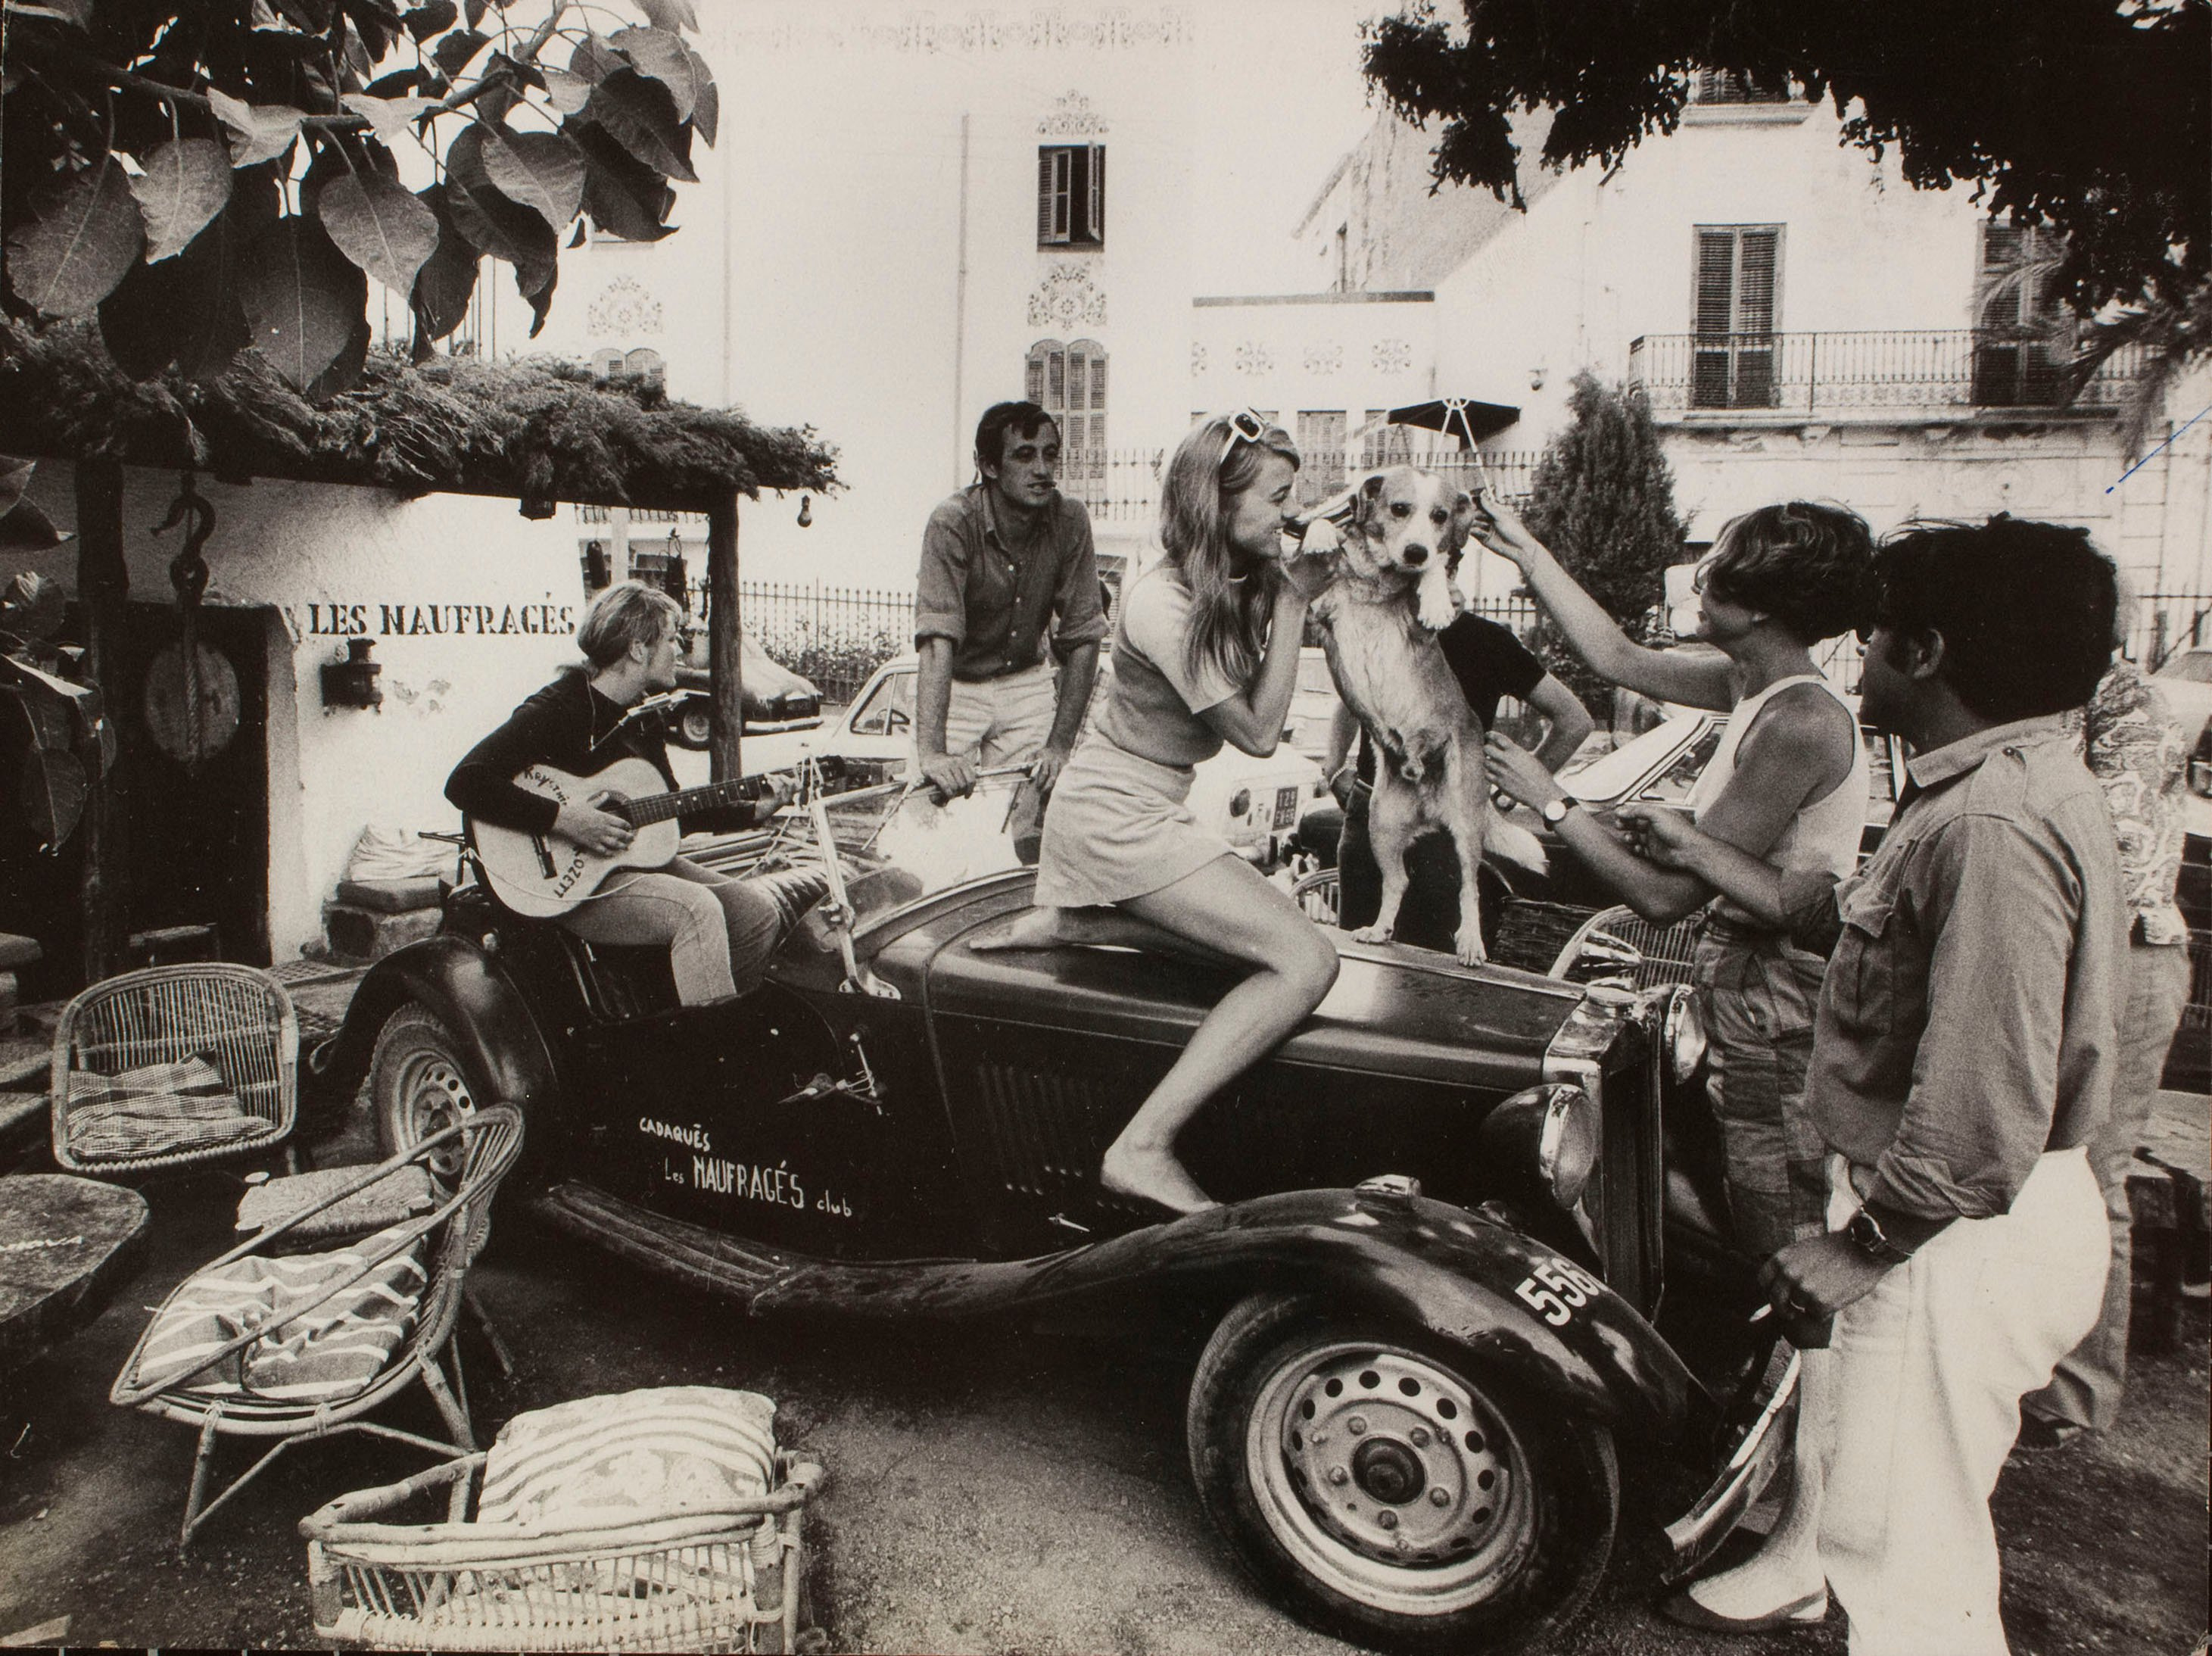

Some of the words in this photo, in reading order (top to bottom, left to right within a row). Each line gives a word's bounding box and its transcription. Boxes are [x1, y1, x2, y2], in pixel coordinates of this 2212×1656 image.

[308, 603, 367, 636] LES
[379, 591, 575, 635] NAUFRAGÉS
[665, 1157, 684, 1184] Les
[693, 1155, 805, 1209] NAUFRAGÉS
[816, 1190, 852, 1218] club
[1515, 1257, 1608, 1326] 556
